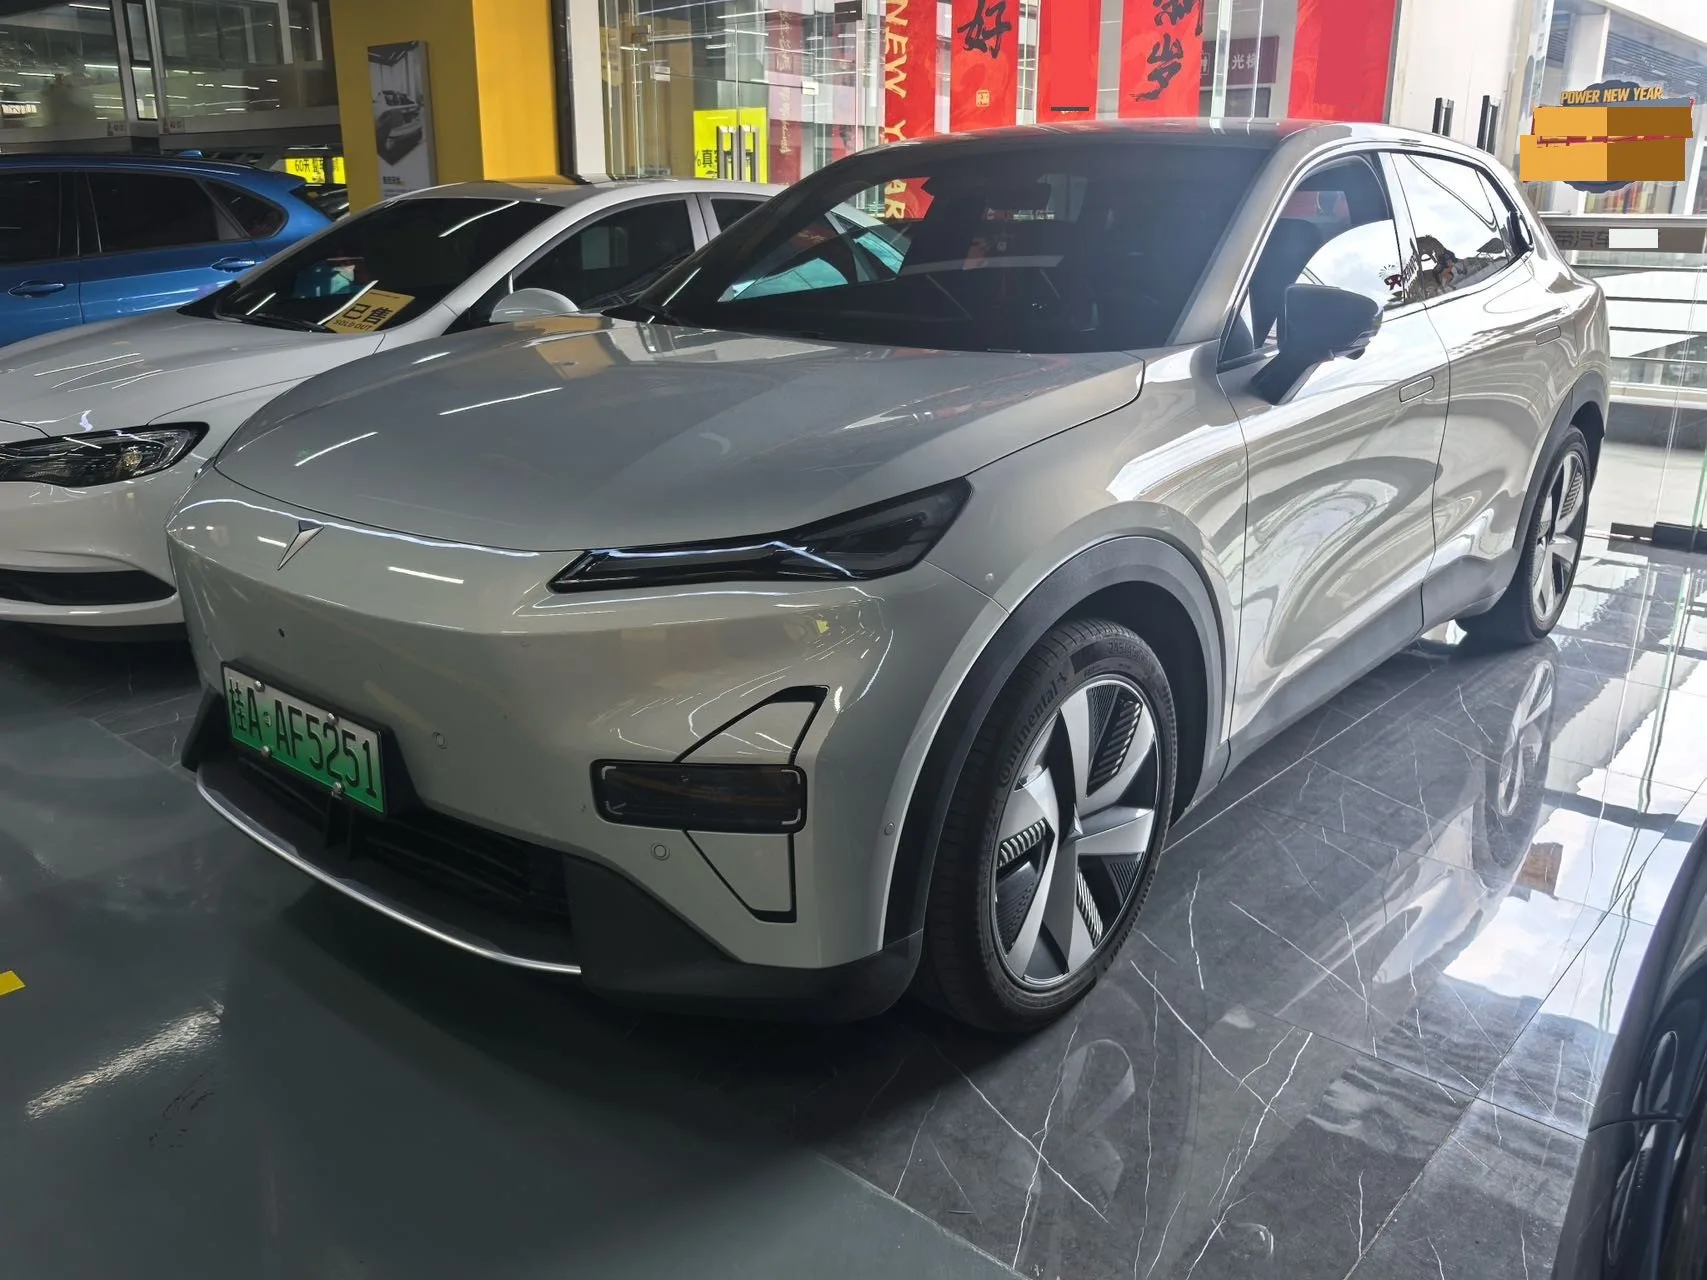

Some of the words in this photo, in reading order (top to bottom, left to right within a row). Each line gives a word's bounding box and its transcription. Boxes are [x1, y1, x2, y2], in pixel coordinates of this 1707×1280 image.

[885, 0, 909, 98] NEW
[957, 0, 1012, 59] 好
[1560, 90, 1600, 104] POWER
[1603, 88, 1630, 102] NEW
[1634, 86, 1663, 100] YEAR
[885, 119, 909, 219] YAR
[332, 319, 355, 328] SOLD
[342, 303, 393, 324] 已售
[1001, 682, 1058, 787] Continental
